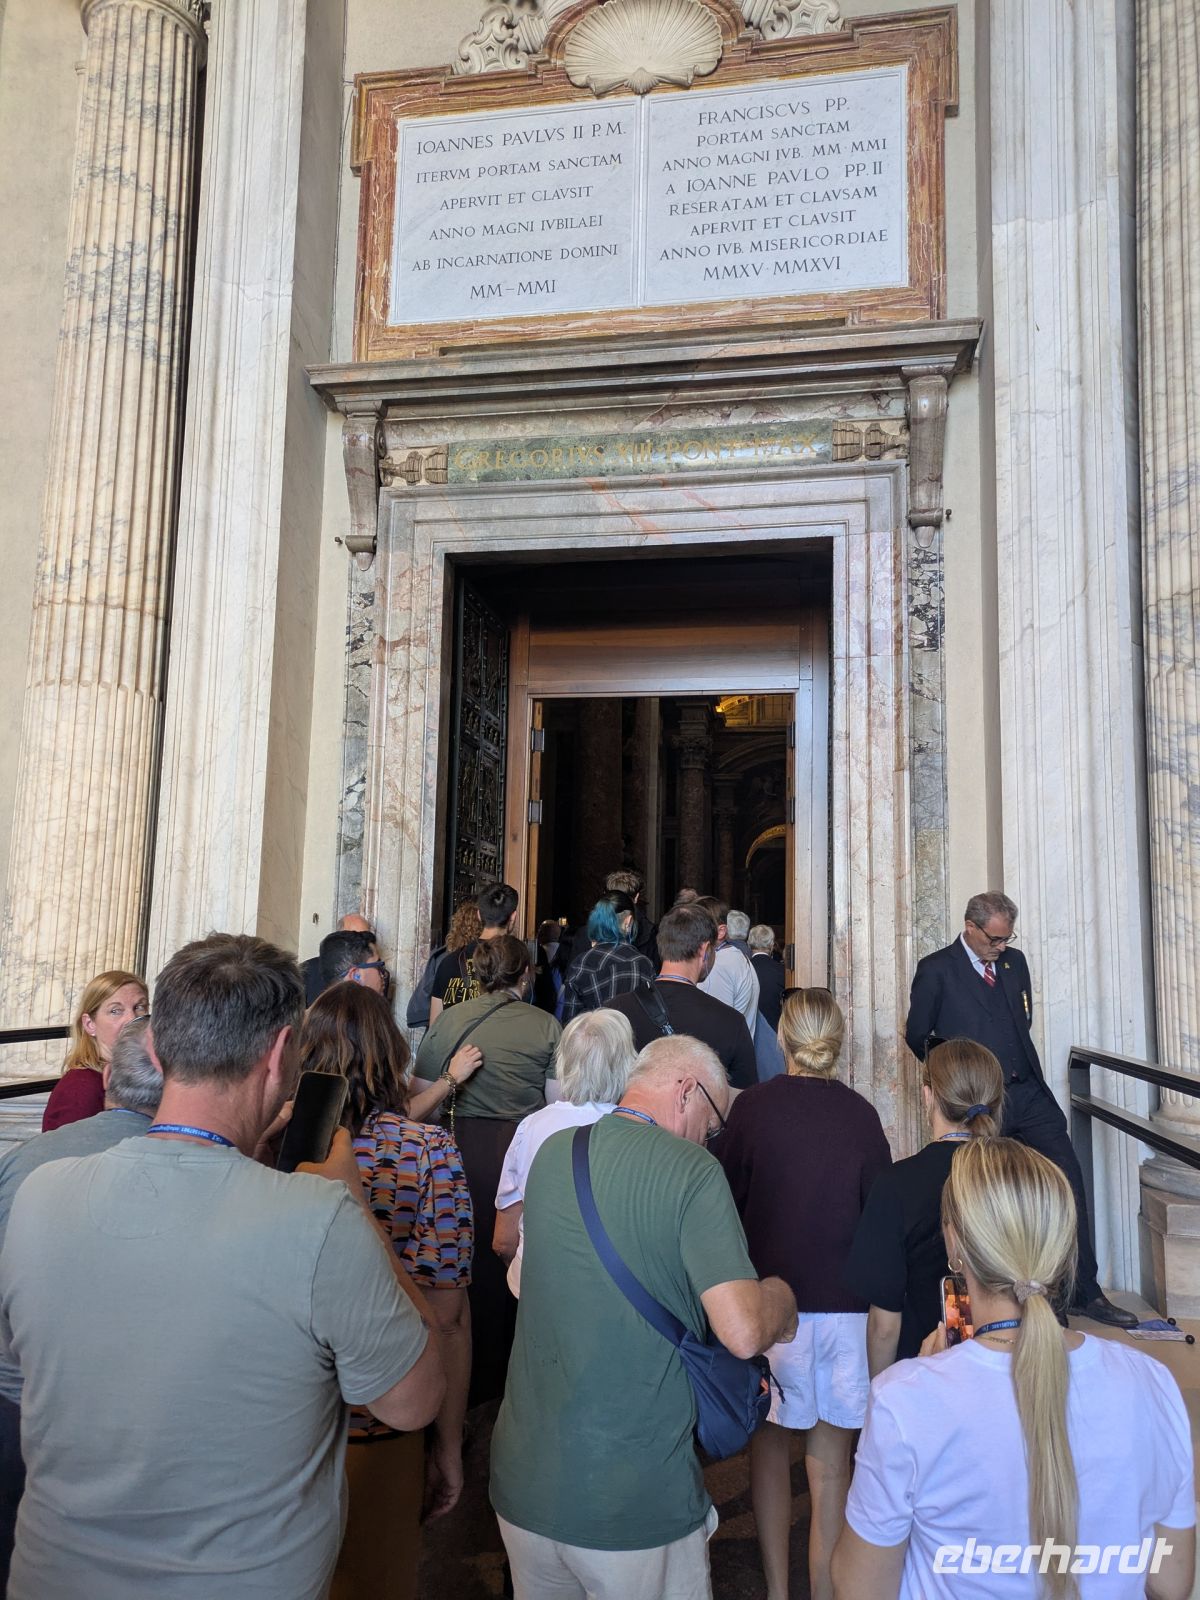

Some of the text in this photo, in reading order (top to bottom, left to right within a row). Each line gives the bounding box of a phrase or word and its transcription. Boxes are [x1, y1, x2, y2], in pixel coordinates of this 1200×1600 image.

[698, 96, 850, 126] FRANCISCVS PP.
[417, 135, 493, 155] IOANNES
[502, 128, 565, 147] PAVLVS
[573, 126, 584, 140] II
[697, 120, 850, 147] PORTAM SANCTAM
[416, 153, 622, 183] ITERVM PORTAM SANCTAM
[662, 157, 711, 172] ANNO
[716, 150, 770, 167] MAGNI
[775, 148, 804, 161] IVB.
[665, 183, 676, 195] A
[687, 173, 756, 194] IOANNE
[768, 166, 829, 185] PAVLO
[440, 185, 594, 211] APERVIT ET CLAVSIT
[669, 186, 878, 217] RESERATAM ET CLAVSAM
[429, 215, 603, 241] ANNO MAGNI IVBILAEI
[690, 210, 857, 237] APERVIT ET CLAVSIT
[412, 244, 618, 272] AB INCARNATIONE DOMINI
[659, 229, 888, 261] ANNO IVB. MISERICORDIAE
